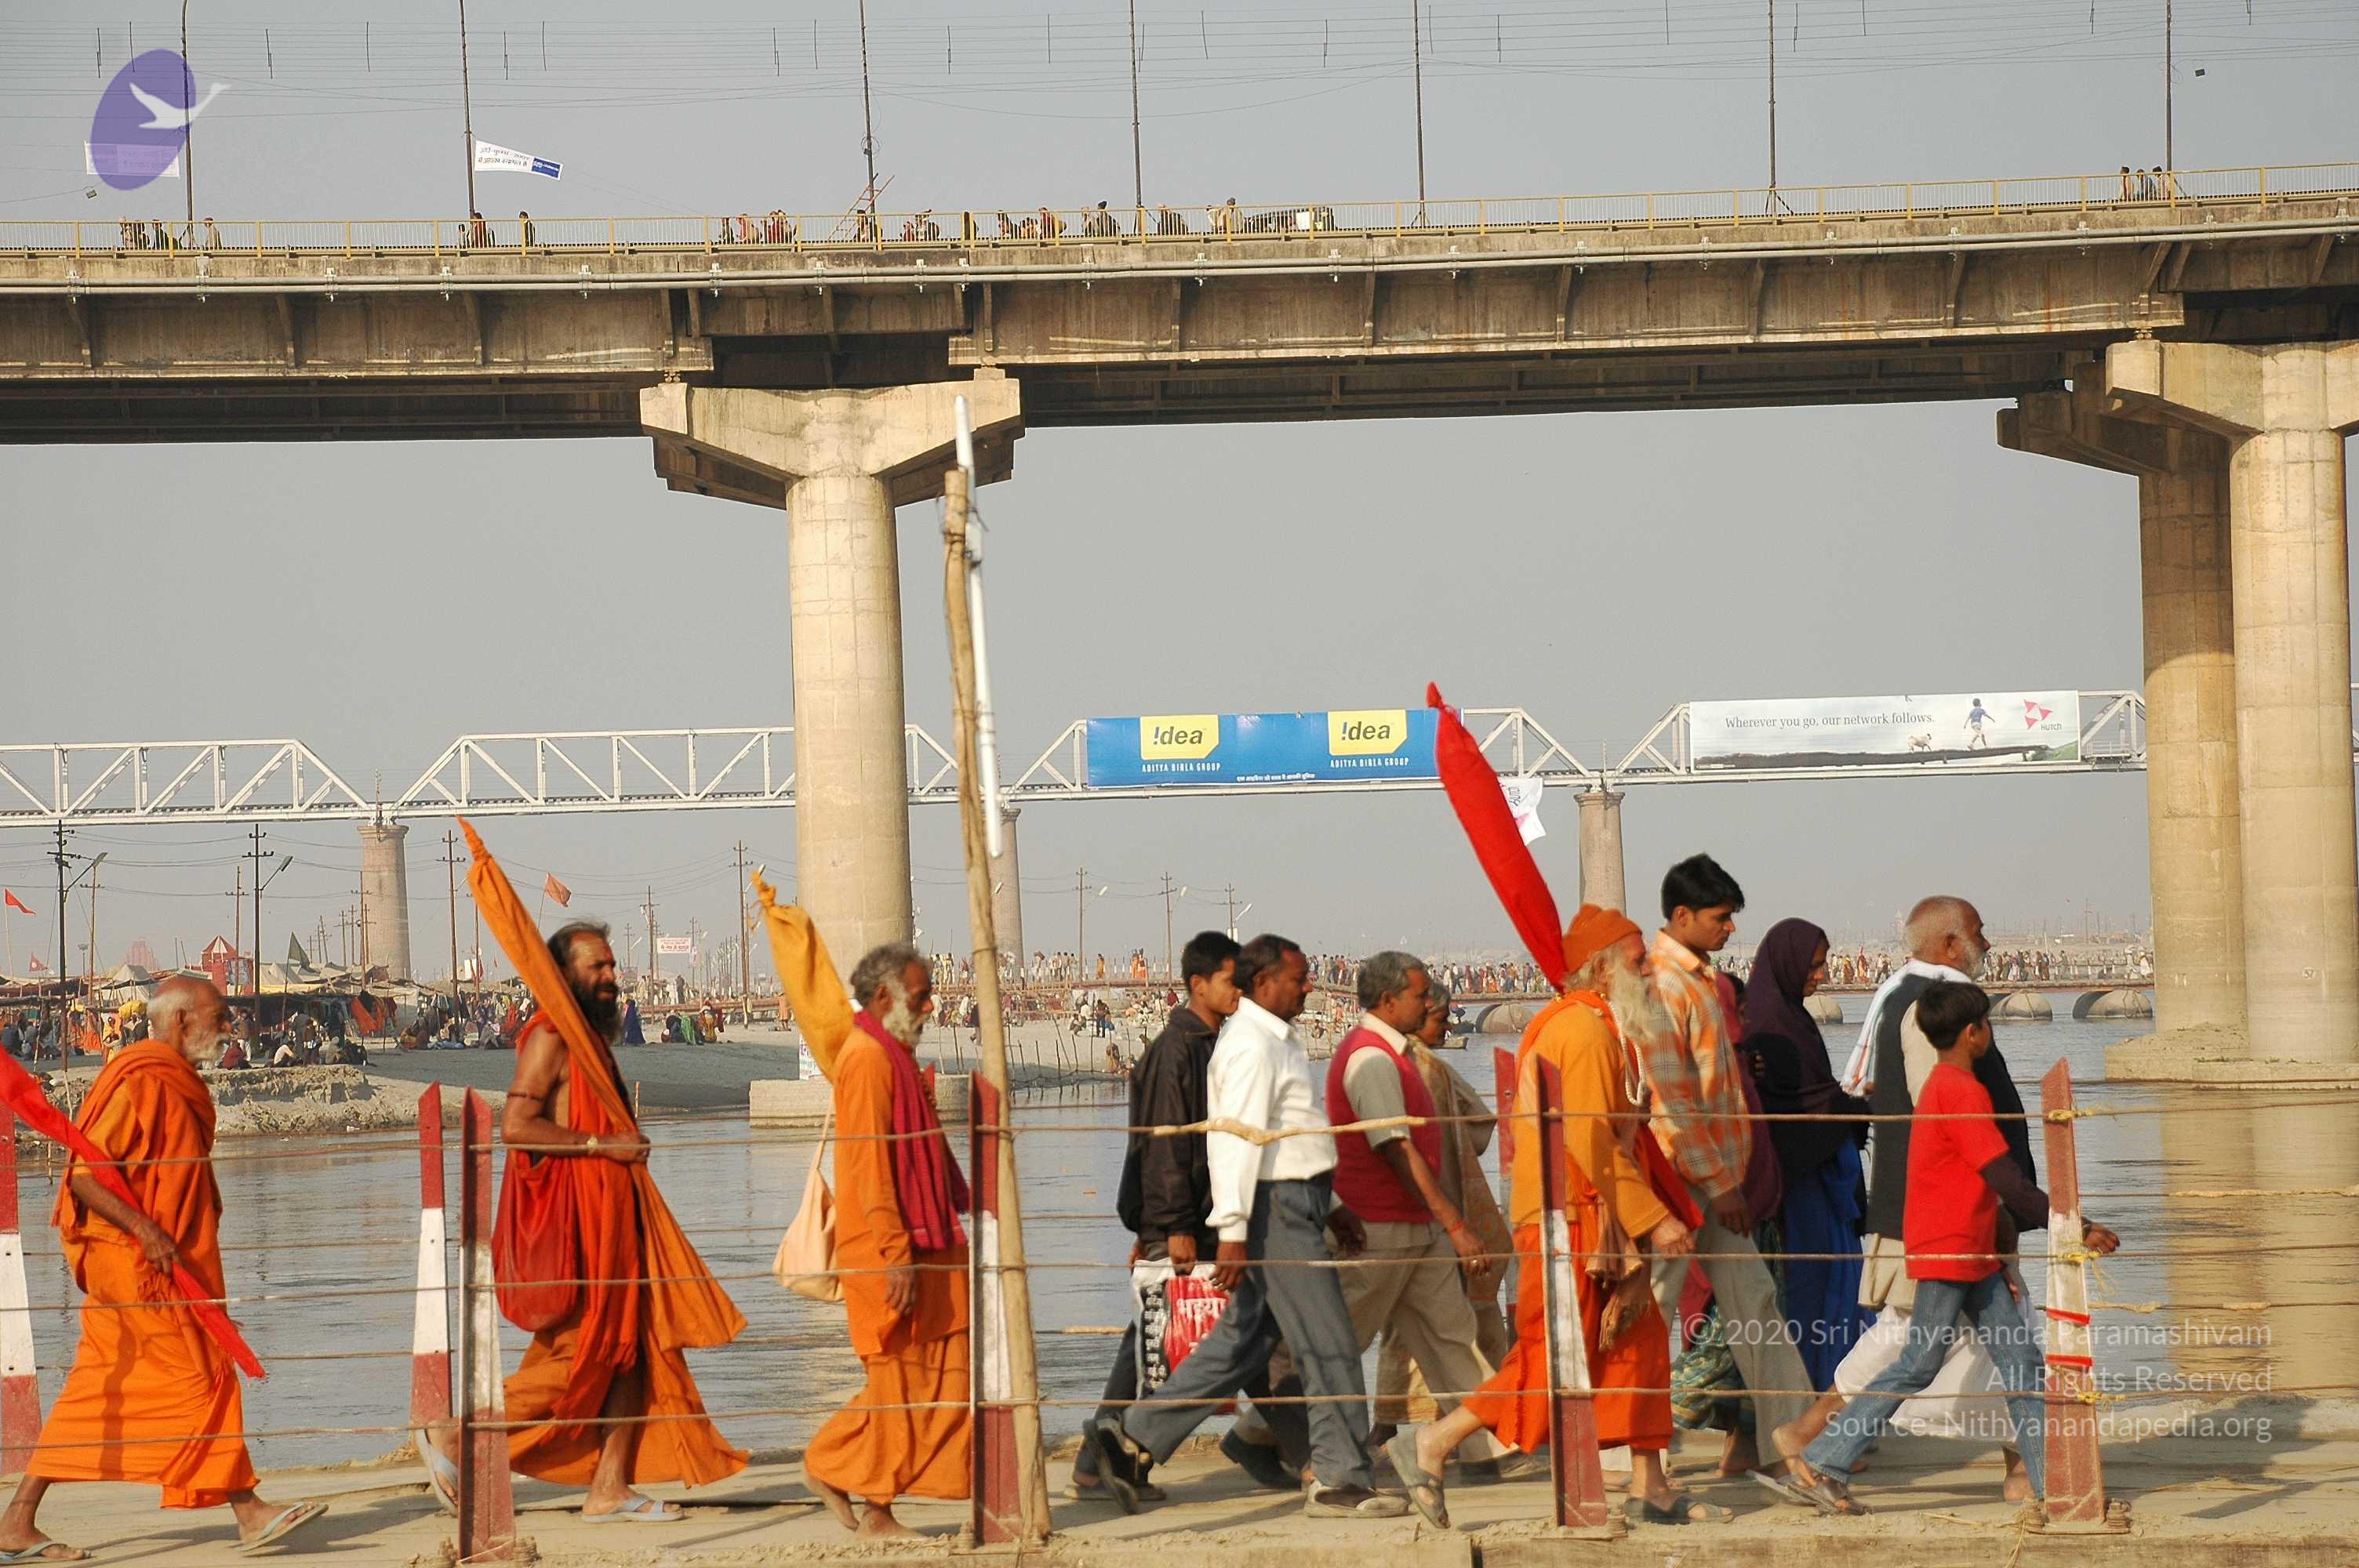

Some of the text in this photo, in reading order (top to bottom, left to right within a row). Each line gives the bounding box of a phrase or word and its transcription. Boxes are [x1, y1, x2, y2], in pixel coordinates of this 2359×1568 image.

[1725, 712, 1936, 730] Wherever you go, our network follows.
[1142, 762, 1221, 773] ADITYA BIRLA GROUP
[1330, 757, 1409, 768] ADITYA BIRLA GROUP
